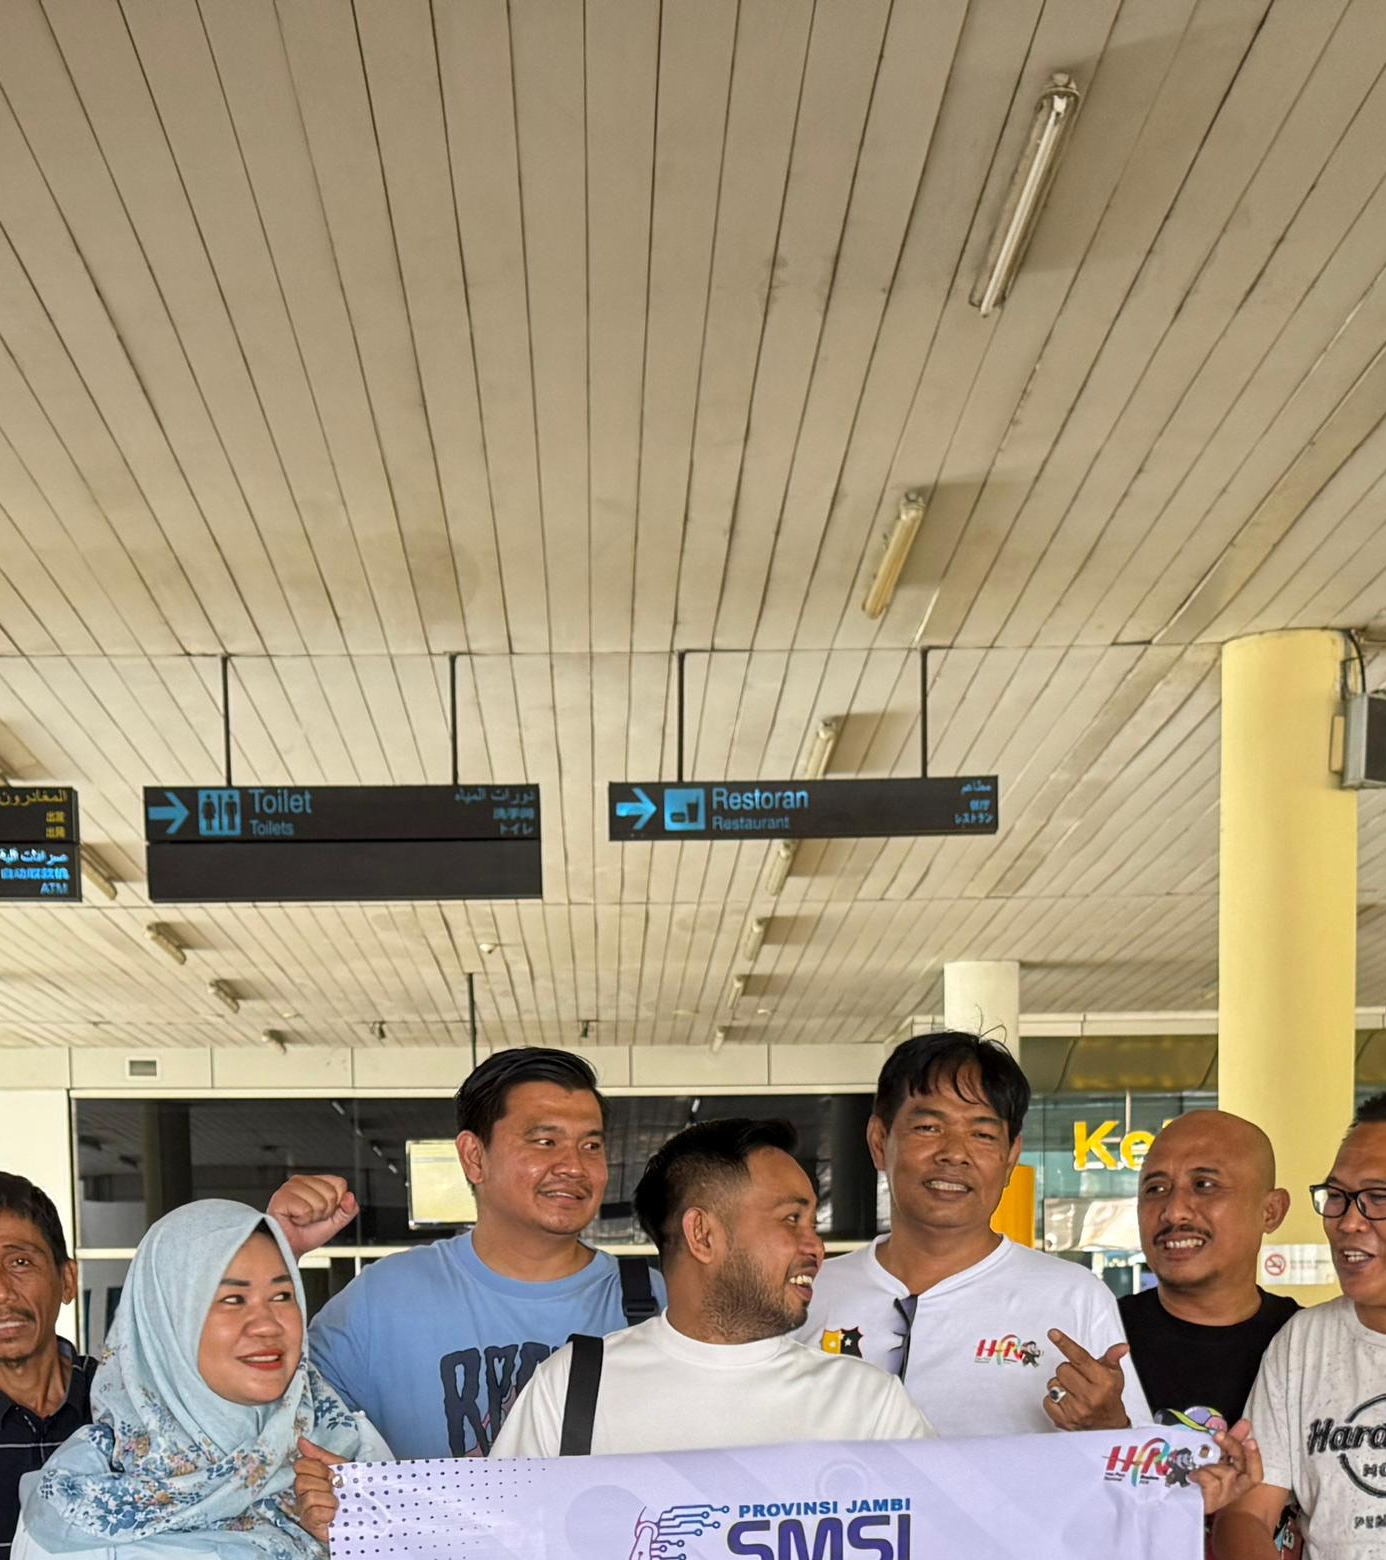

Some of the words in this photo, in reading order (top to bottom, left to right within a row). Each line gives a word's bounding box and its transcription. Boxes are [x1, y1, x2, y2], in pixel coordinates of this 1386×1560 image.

[248, 788, 312, 814] Toilet
[712, 787, 809, 810] Restoran
[249, 819, 294, 836] Toilets
[712, 815, 790, 831] Restaurant
[739, 1501, 838, 1518] PROVINSI
[846, 1498, 911, 1513] JAMBI
